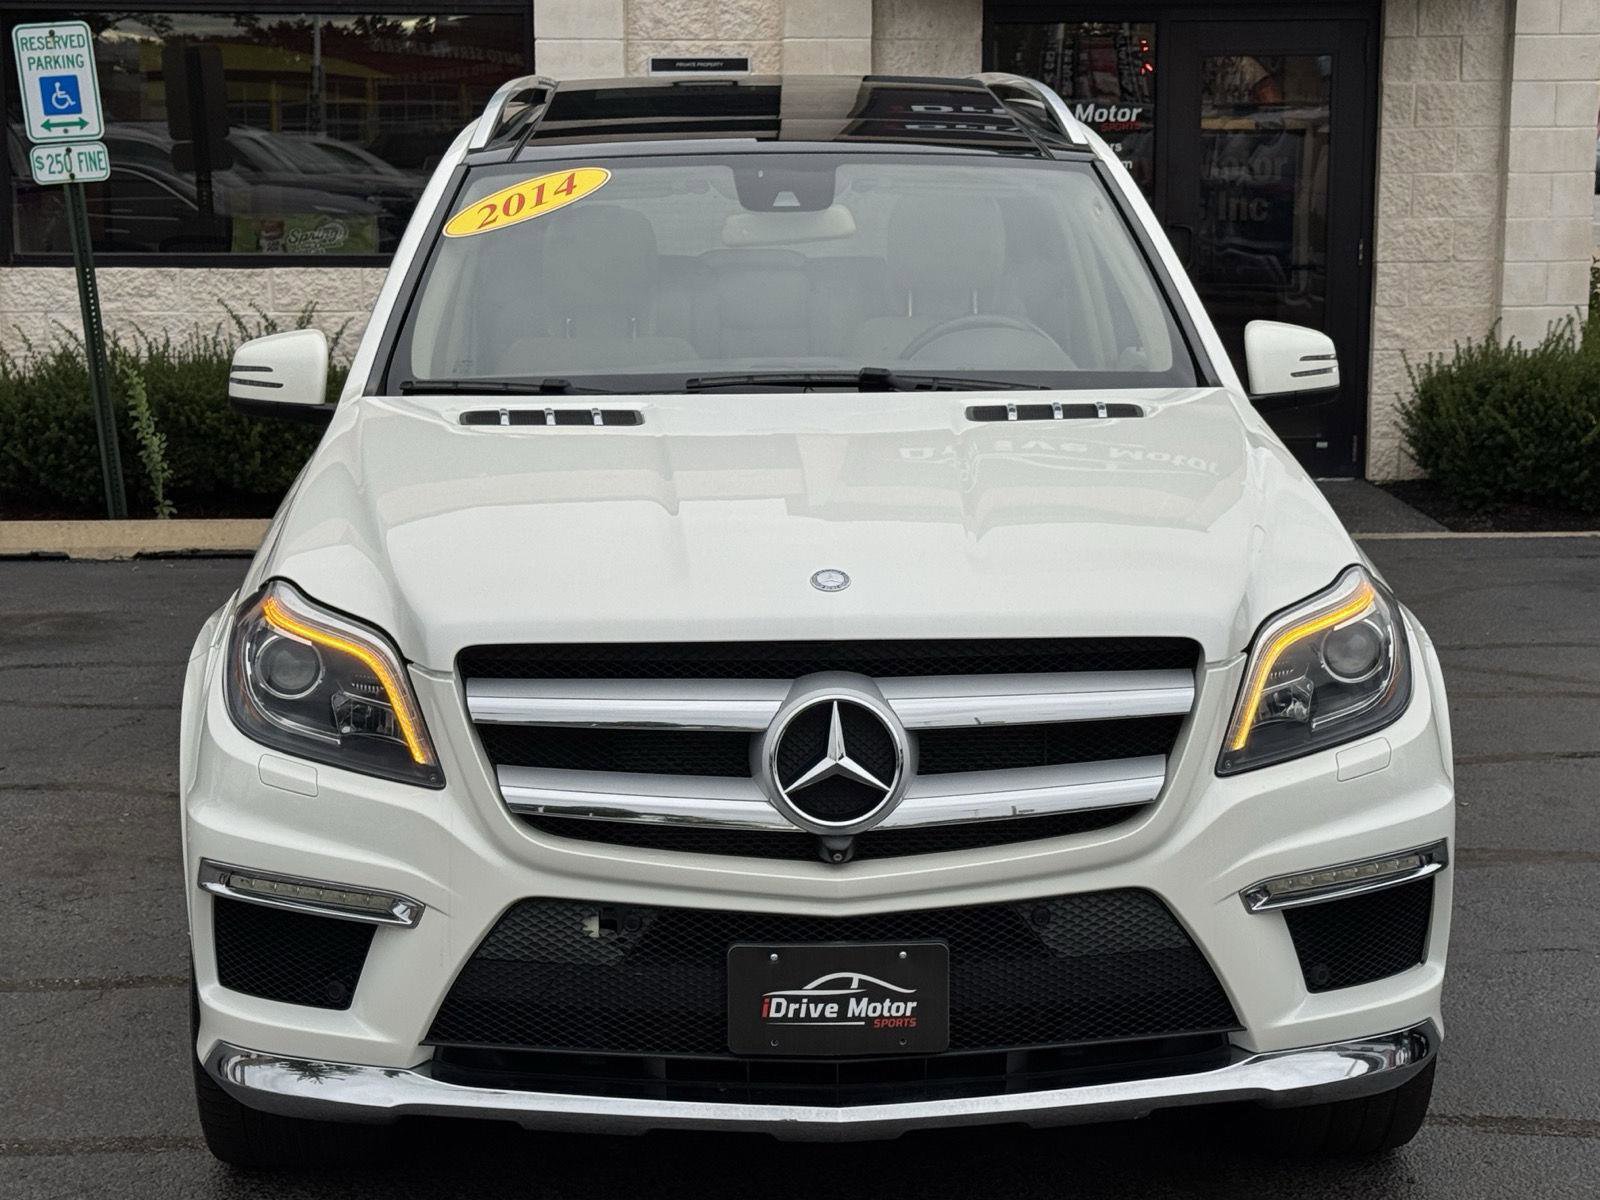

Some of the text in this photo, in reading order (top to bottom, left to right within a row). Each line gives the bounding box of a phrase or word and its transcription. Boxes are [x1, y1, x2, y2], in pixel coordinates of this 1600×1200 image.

[20, 34, 86, 52] RESERVED
[27, 54, 85, 71] PARKING
[1075, 103, 1143, 122] Motor
[35, 150, 106, 175] $250 FINE
[476, 172, 578, 230] 2014
[761, 996, 918, 1018] iDrive Motor
[873, 1018, 917, 1029] SPORTS
